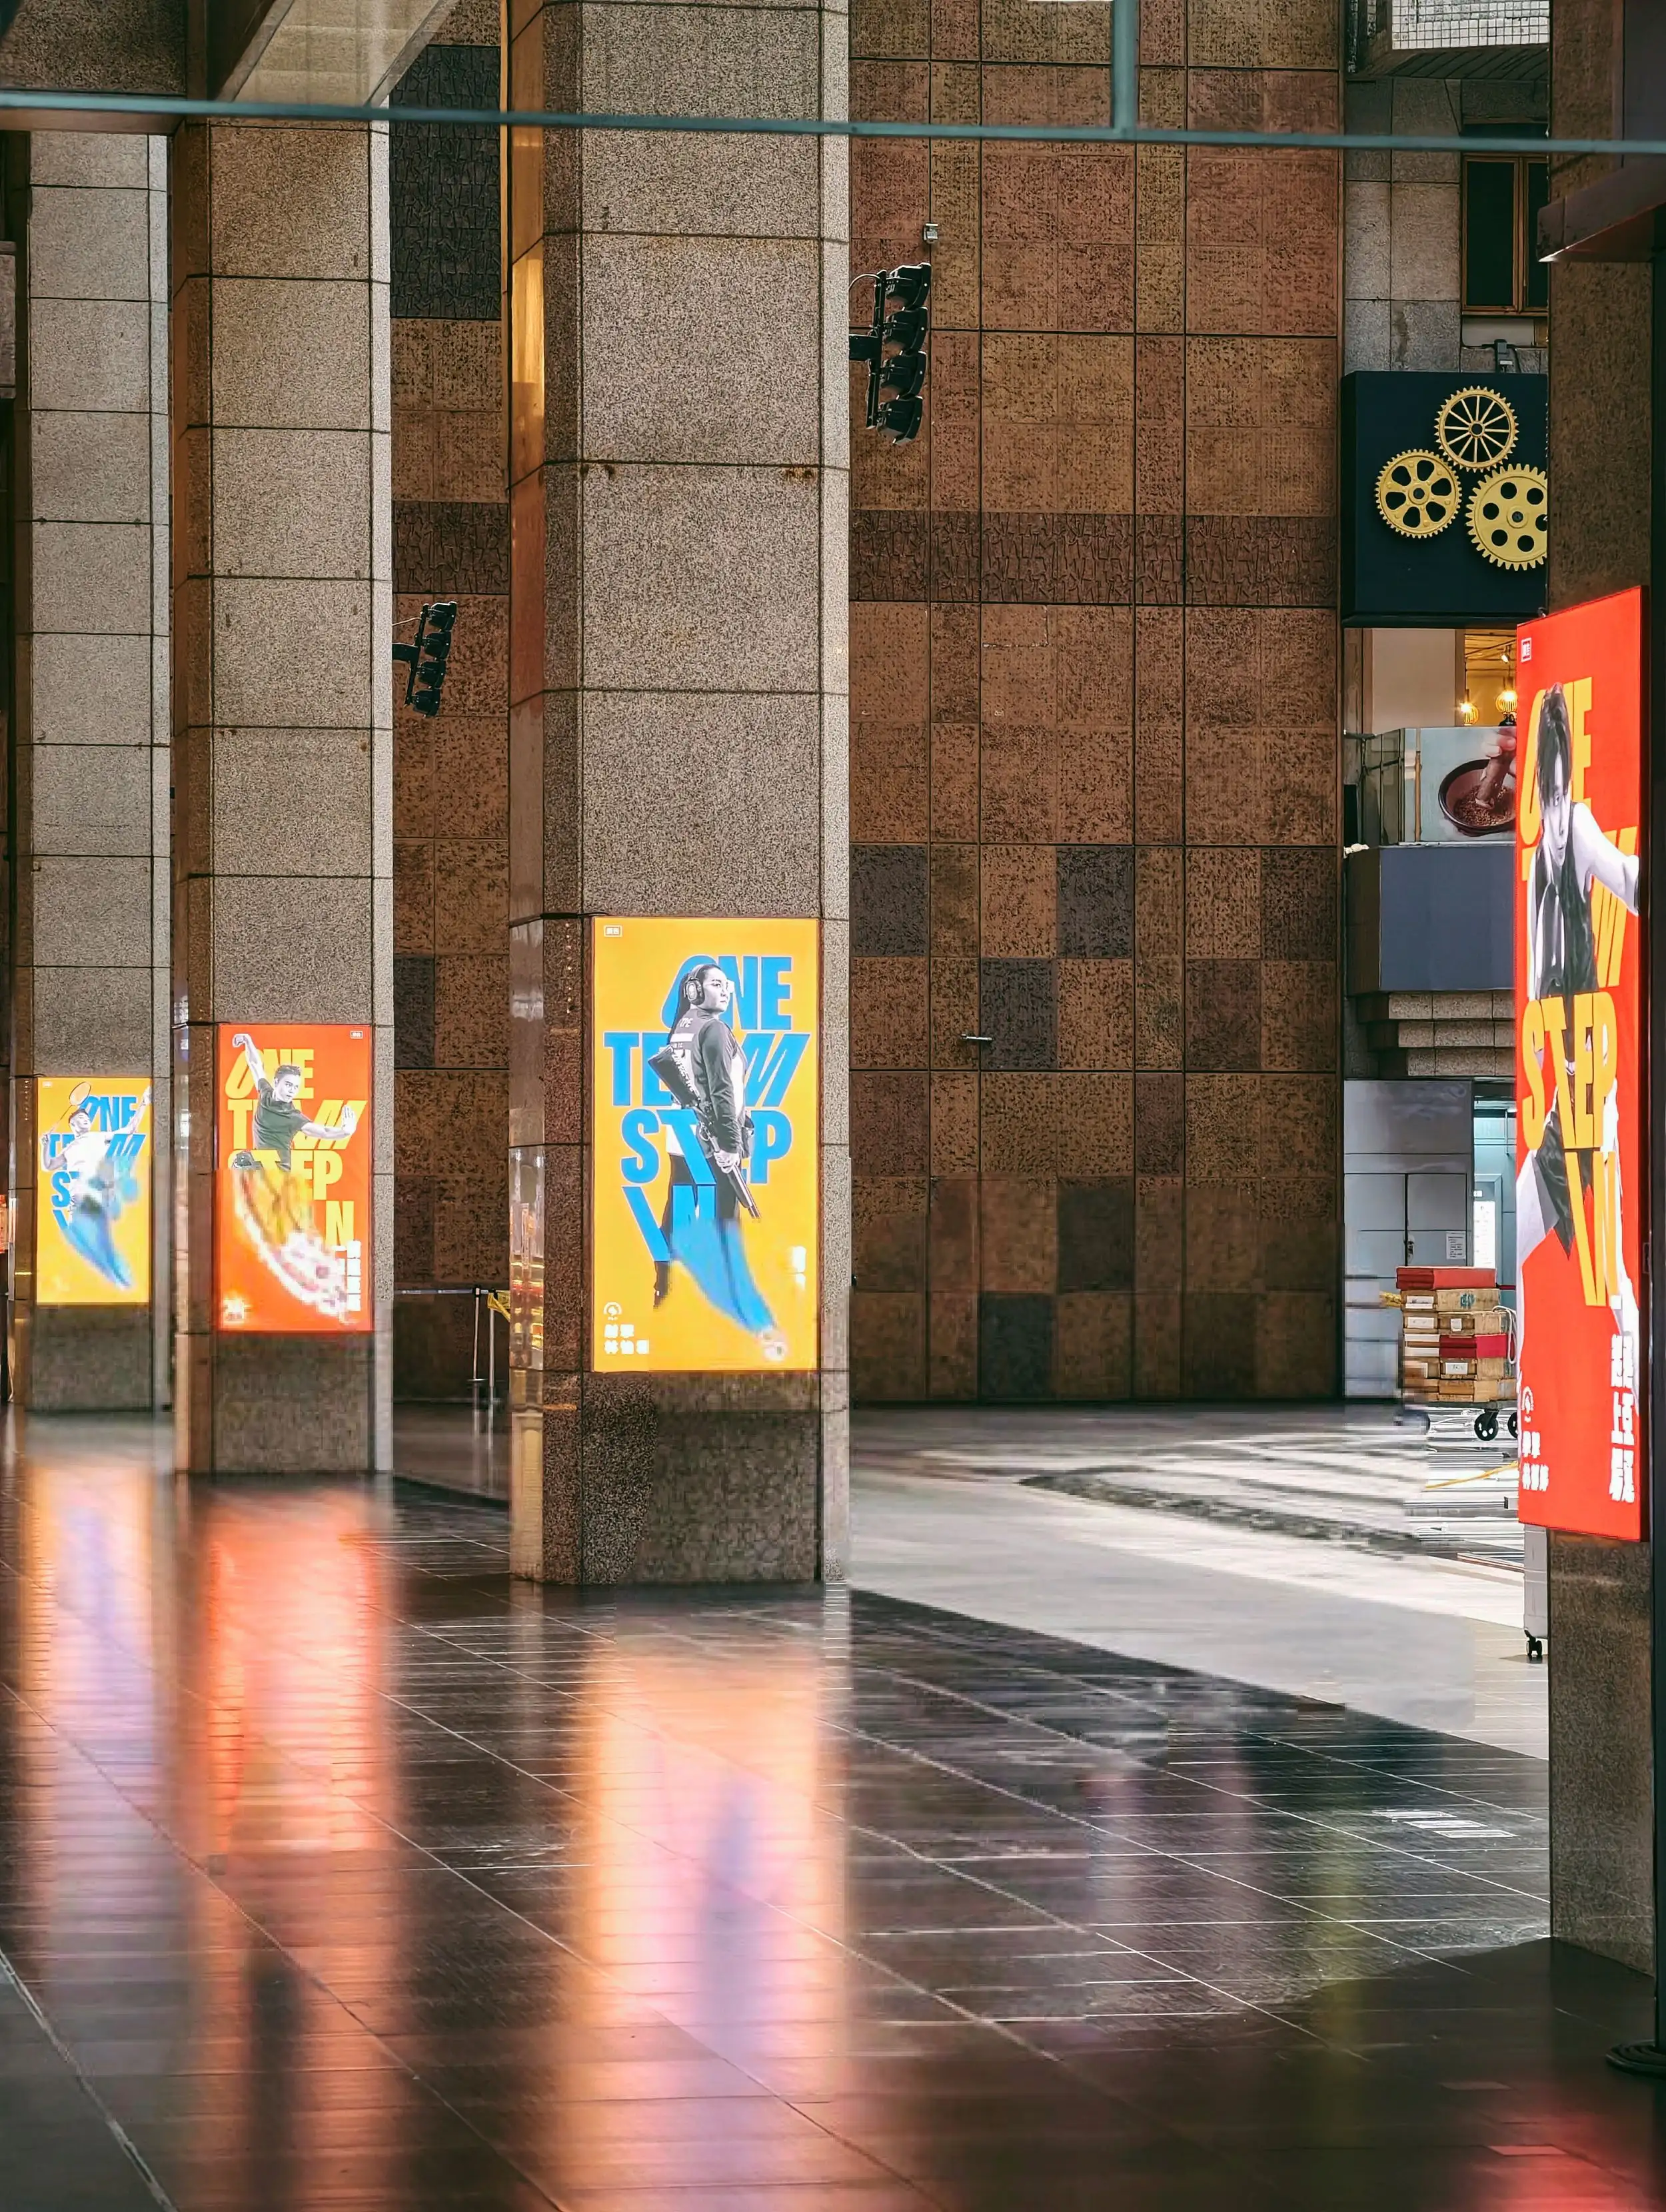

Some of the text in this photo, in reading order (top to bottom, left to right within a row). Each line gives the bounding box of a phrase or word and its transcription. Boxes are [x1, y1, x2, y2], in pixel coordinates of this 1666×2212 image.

[1520, 677, 1592, 845] OE
[604, 1032, 811, 1107] TEM
[1522, 991, 1617, 1150] STEP
[620, 1108, 793, 1185] STP
